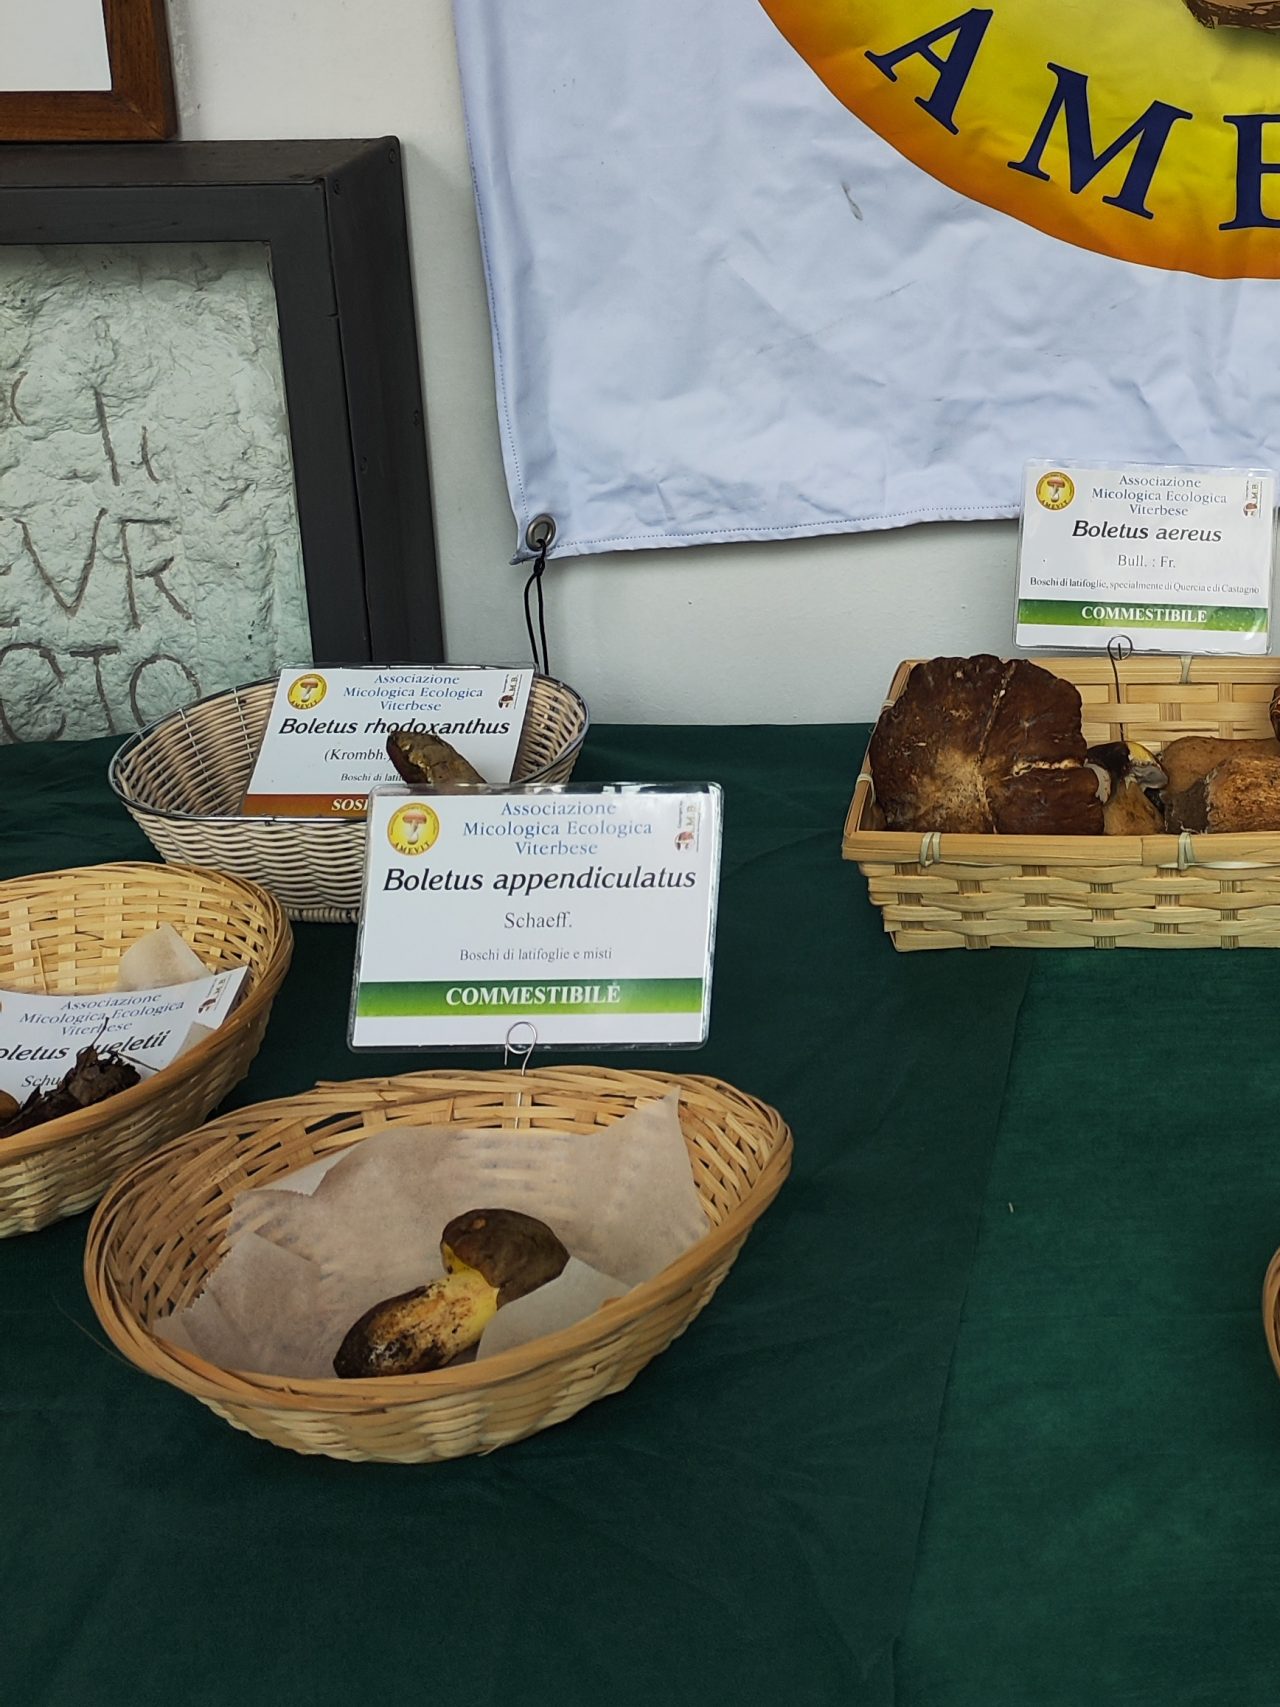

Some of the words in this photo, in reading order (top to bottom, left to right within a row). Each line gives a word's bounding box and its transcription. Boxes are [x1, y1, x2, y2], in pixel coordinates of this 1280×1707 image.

[1119, 475, 1202, 488] Associazione
[1092, 487, 1161, 503] Micologica
[1166, 490, 1227, 504] Ecologica
[1129, 504, 1189, 516] Viterbese
[1072, 520, 1149, 540] Boletus
[1156, 527, 1222, 542] aereus
[1118, 555, 1147, 568] Bull.
[1160, 556, 1176, 569] Fr.
[1030, 577, 1058, 587] Boschi
[1060, 577, 1068, 587] di
[1110, 581, 1163, 592] specialmente
[1164, 582, 1172, 591] di
[1173, 582, 1205, 592] Quercia
[1212, 582, 1220, 592] di
[1221, 583, 1259, 595] Castagno
[1081, 606, 1207, 623] COMMESTIBILE
[374, 674, 459, 685] Associazione
[343, 687, 414, 699] Micologica
[420, 688, 483, 699] Ecologica
[380, 701, 442, 711] Viterbese
[278, 718, 358, 734] Boletus
[364, 718, 510, 735] rhodoxanthus
[340, 773, 371, 782] Boschi
[373, 773, 382, 782] di
[500, 801, 617, 817] Associazione
[463, 821, 559, 839] Micologica
[567, 820, 652, 838] Ecologica
[514, 841, 598, 856] Viterbese
[383, 868, 483, 892] Boletus
[492, 866, 696, 897] appendiculatus
[504, 912, 573, 929] Schaeff.
[460, 949, 500, 961] Boschi
[502, 949, 514, 961] di
[517, 948, 570, 963] latifoglie
[573, 952, 580, 960] e
[583, 947, 612, 960] misti
[61, 992, 162, 1011] Associazione
[446, 983, 620, 1006] COMMESTIBILE
[19, 1012, 105, 1024] Micologica
[112, 1001, 185, 1018] Ecologica
